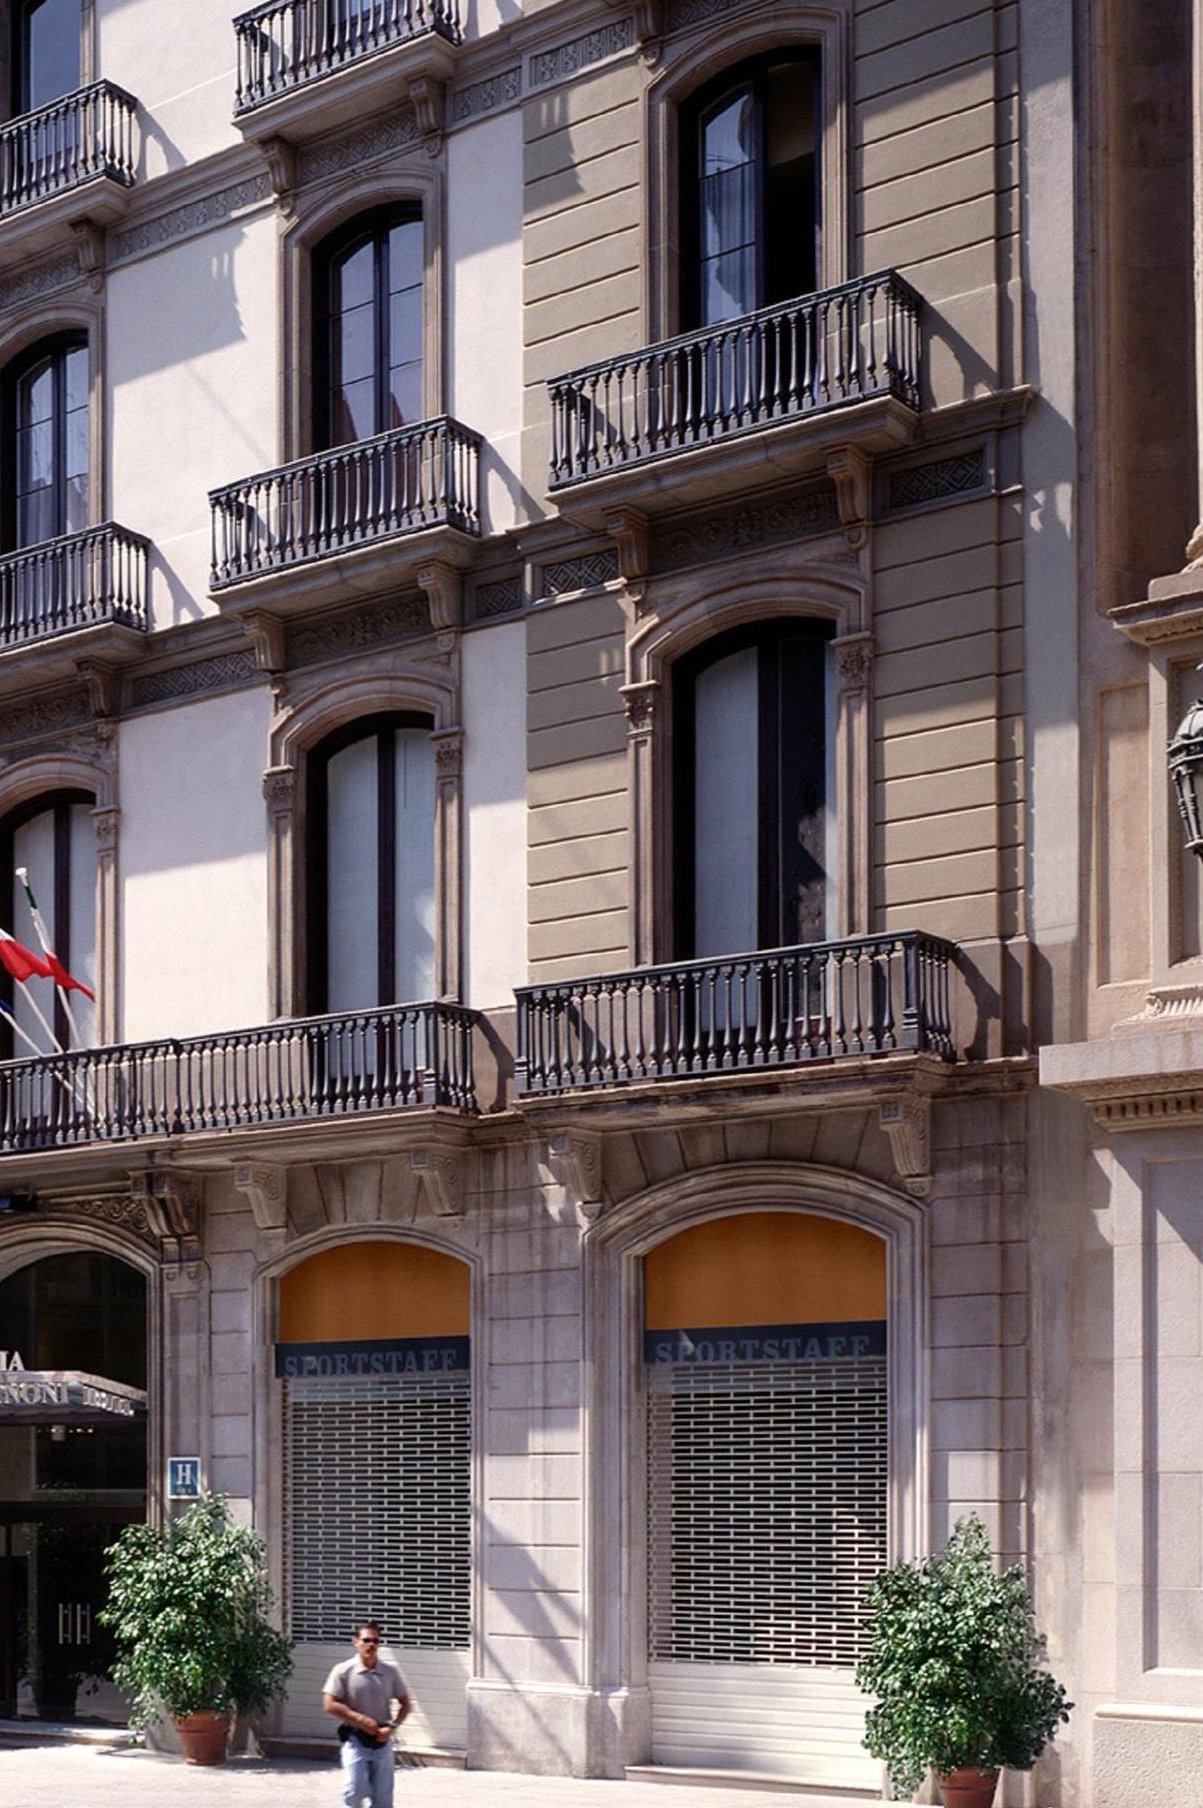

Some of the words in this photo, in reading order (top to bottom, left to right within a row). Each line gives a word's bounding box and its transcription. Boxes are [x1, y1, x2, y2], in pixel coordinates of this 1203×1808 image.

[654, 1334, 870, 1363] SPORTSTAFF
[285, 1350, 458, 1377] SPORTSTAFF
[176, 1463, 192, 1485] H
